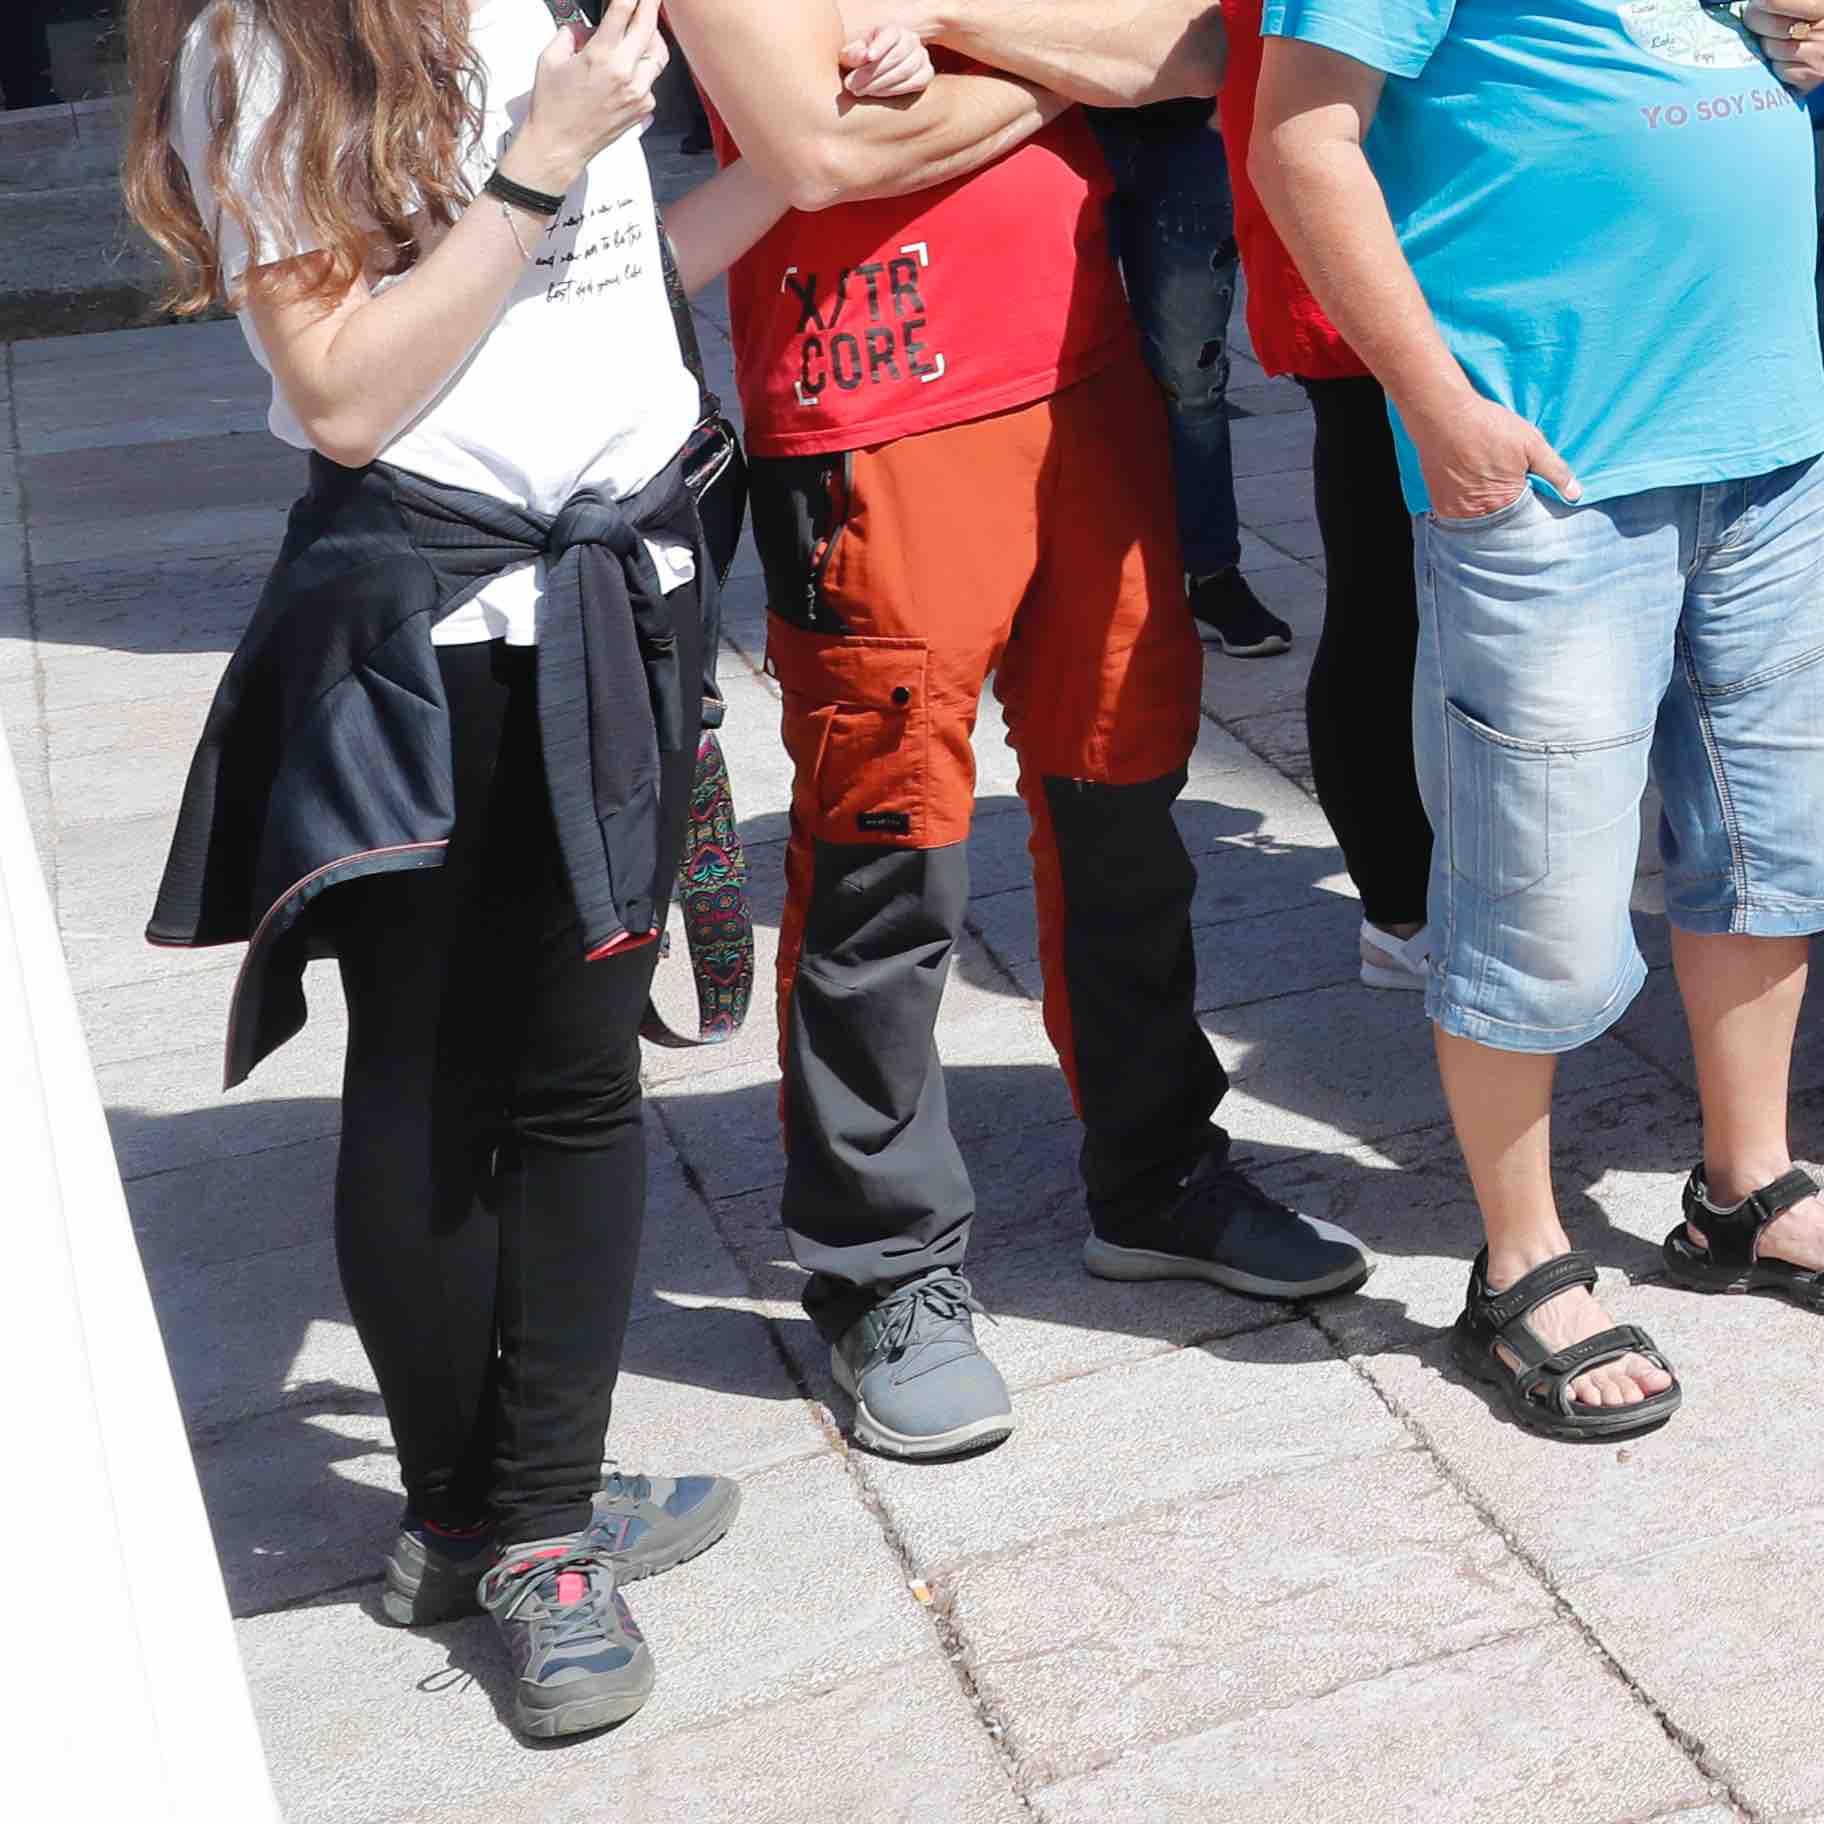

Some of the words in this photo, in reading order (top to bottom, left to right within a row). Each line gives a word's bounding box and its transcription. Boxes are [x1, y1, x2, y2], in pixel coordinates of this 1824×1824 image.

[1640, 104, 1688, 129] YO
[1696, 94, 1745, 121] SOY
[801, 318, 934, 395] CORE
